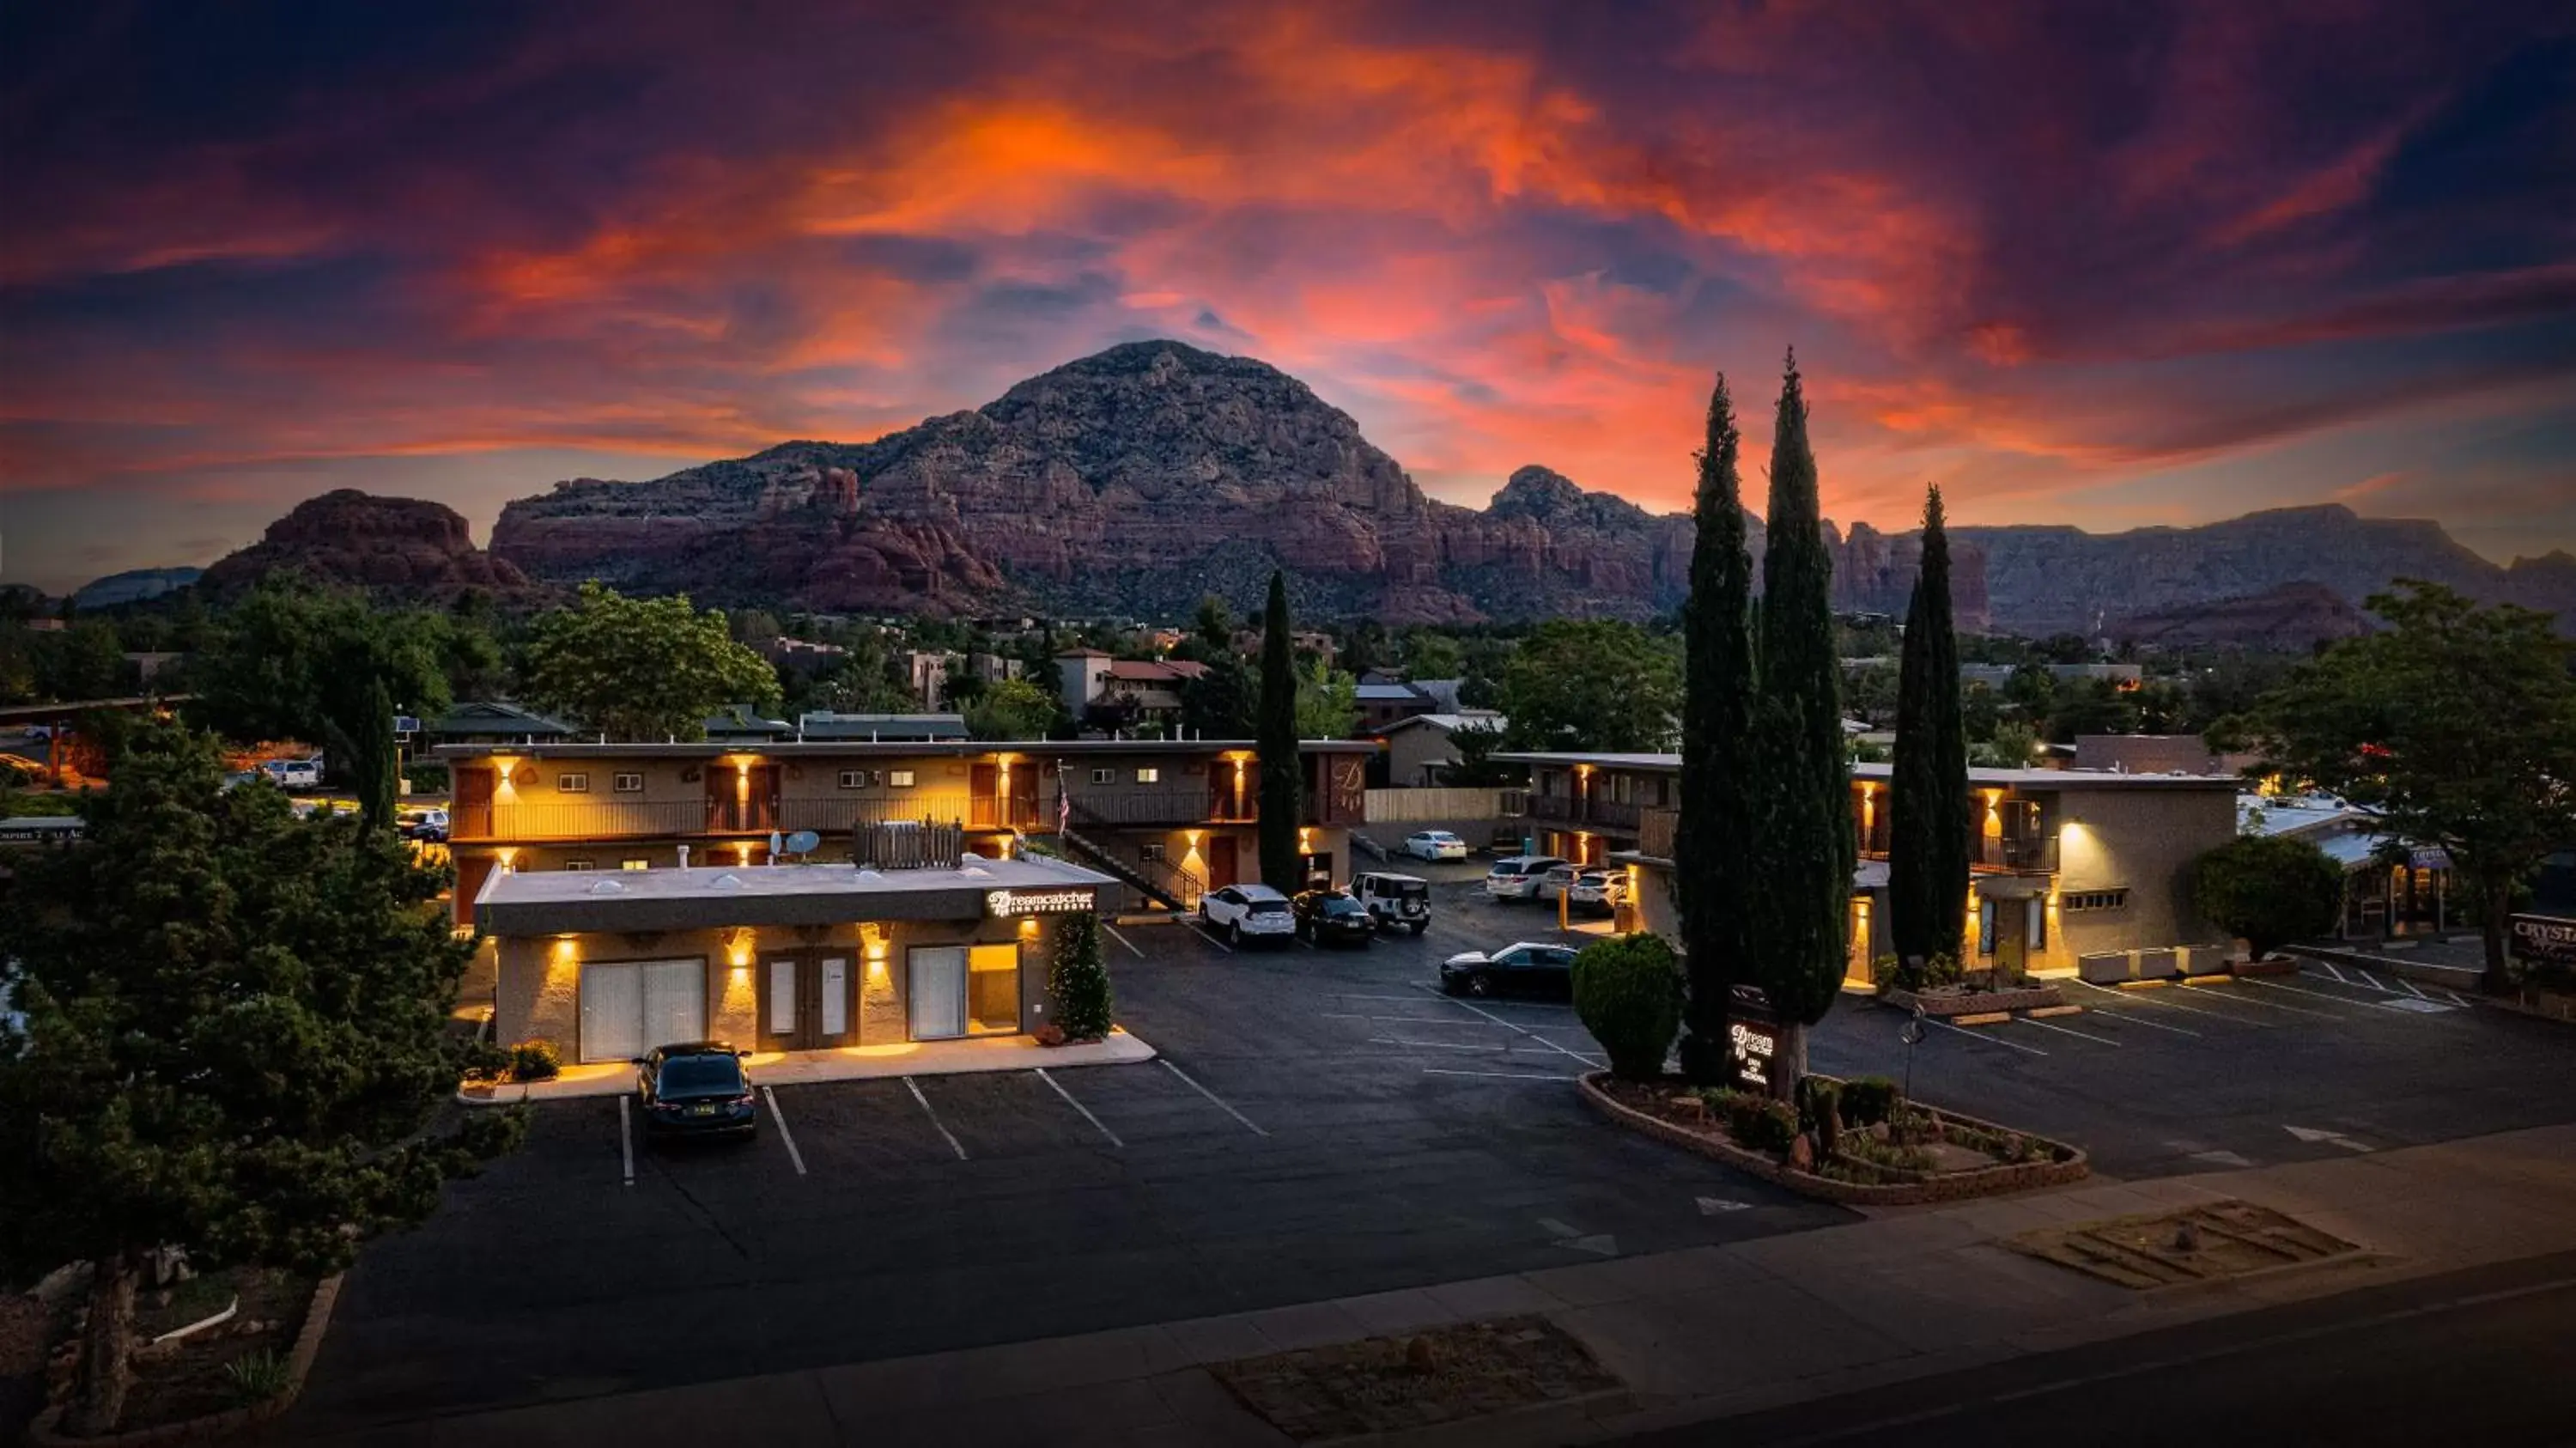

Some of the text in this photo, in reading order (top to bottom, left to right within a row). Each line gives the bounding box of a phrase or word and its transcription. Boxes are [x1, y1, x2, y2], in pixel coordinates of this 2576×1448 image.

[988, 891, 1093, 909] Dreamcatcher
[2513, 922, 2576, 942] CRYST
[1732, 1025, 1773, 1049] Dream
